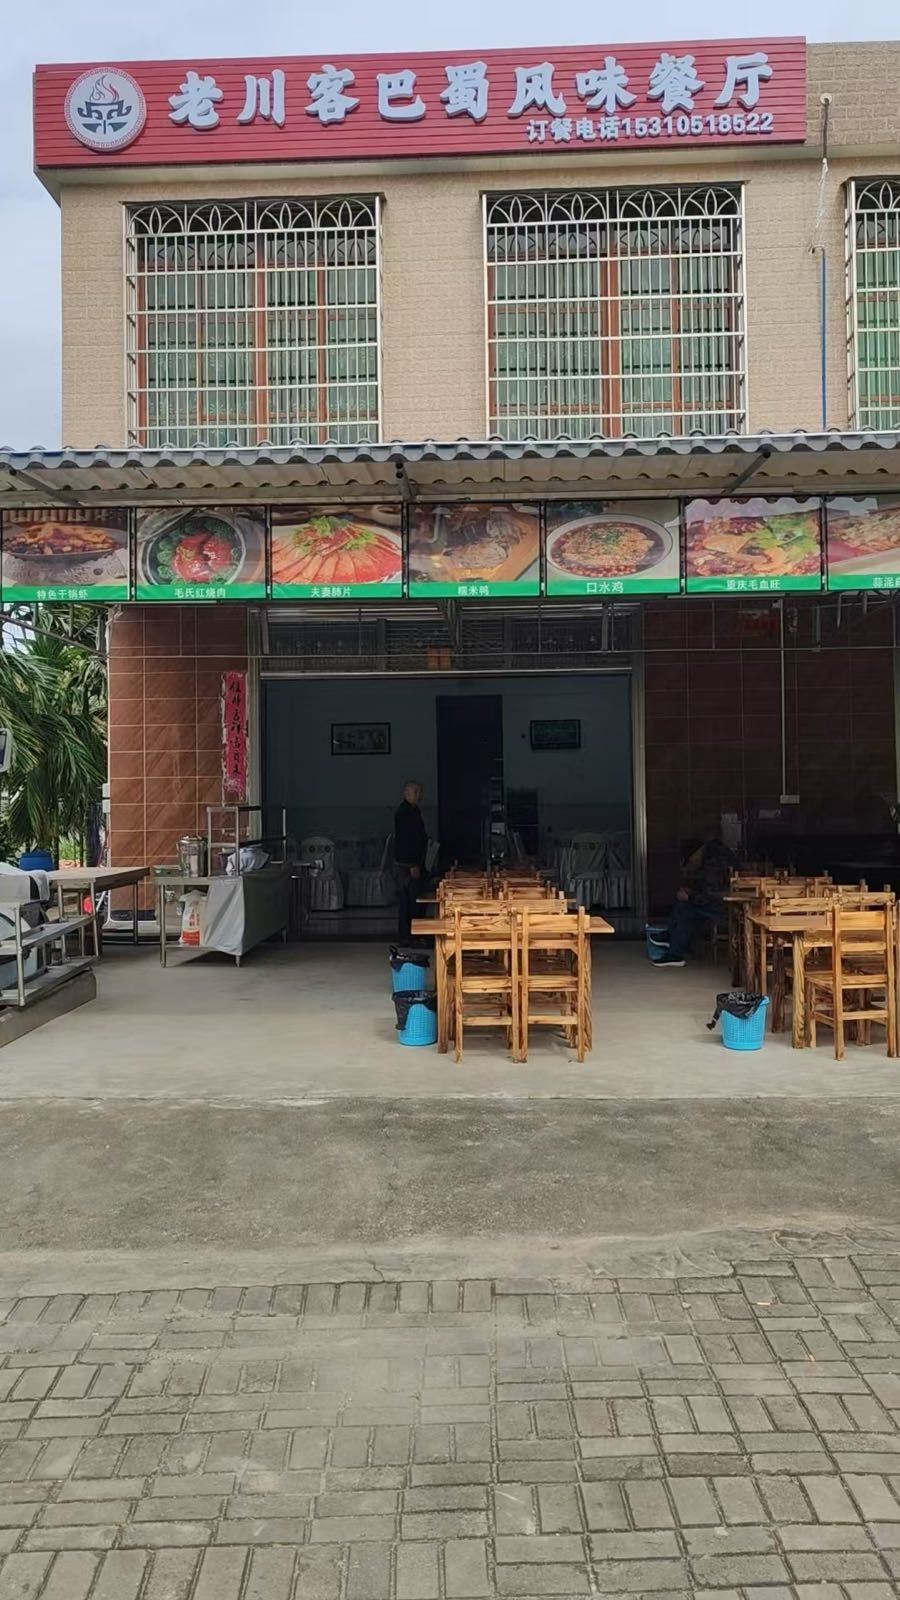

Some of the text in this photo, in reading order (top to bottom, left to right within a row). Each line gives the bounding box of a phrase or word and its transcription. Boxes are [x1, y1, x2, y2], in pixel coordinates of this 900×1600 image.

[168, 52, 774, 130] 老川客巴蜀风味餐厅
[526, 112, 774, 143] 订餐电话15310518522
[586, 581, 624, 594] 口水鸡
[726, 579, 781, 591] 重庆毛血旺
